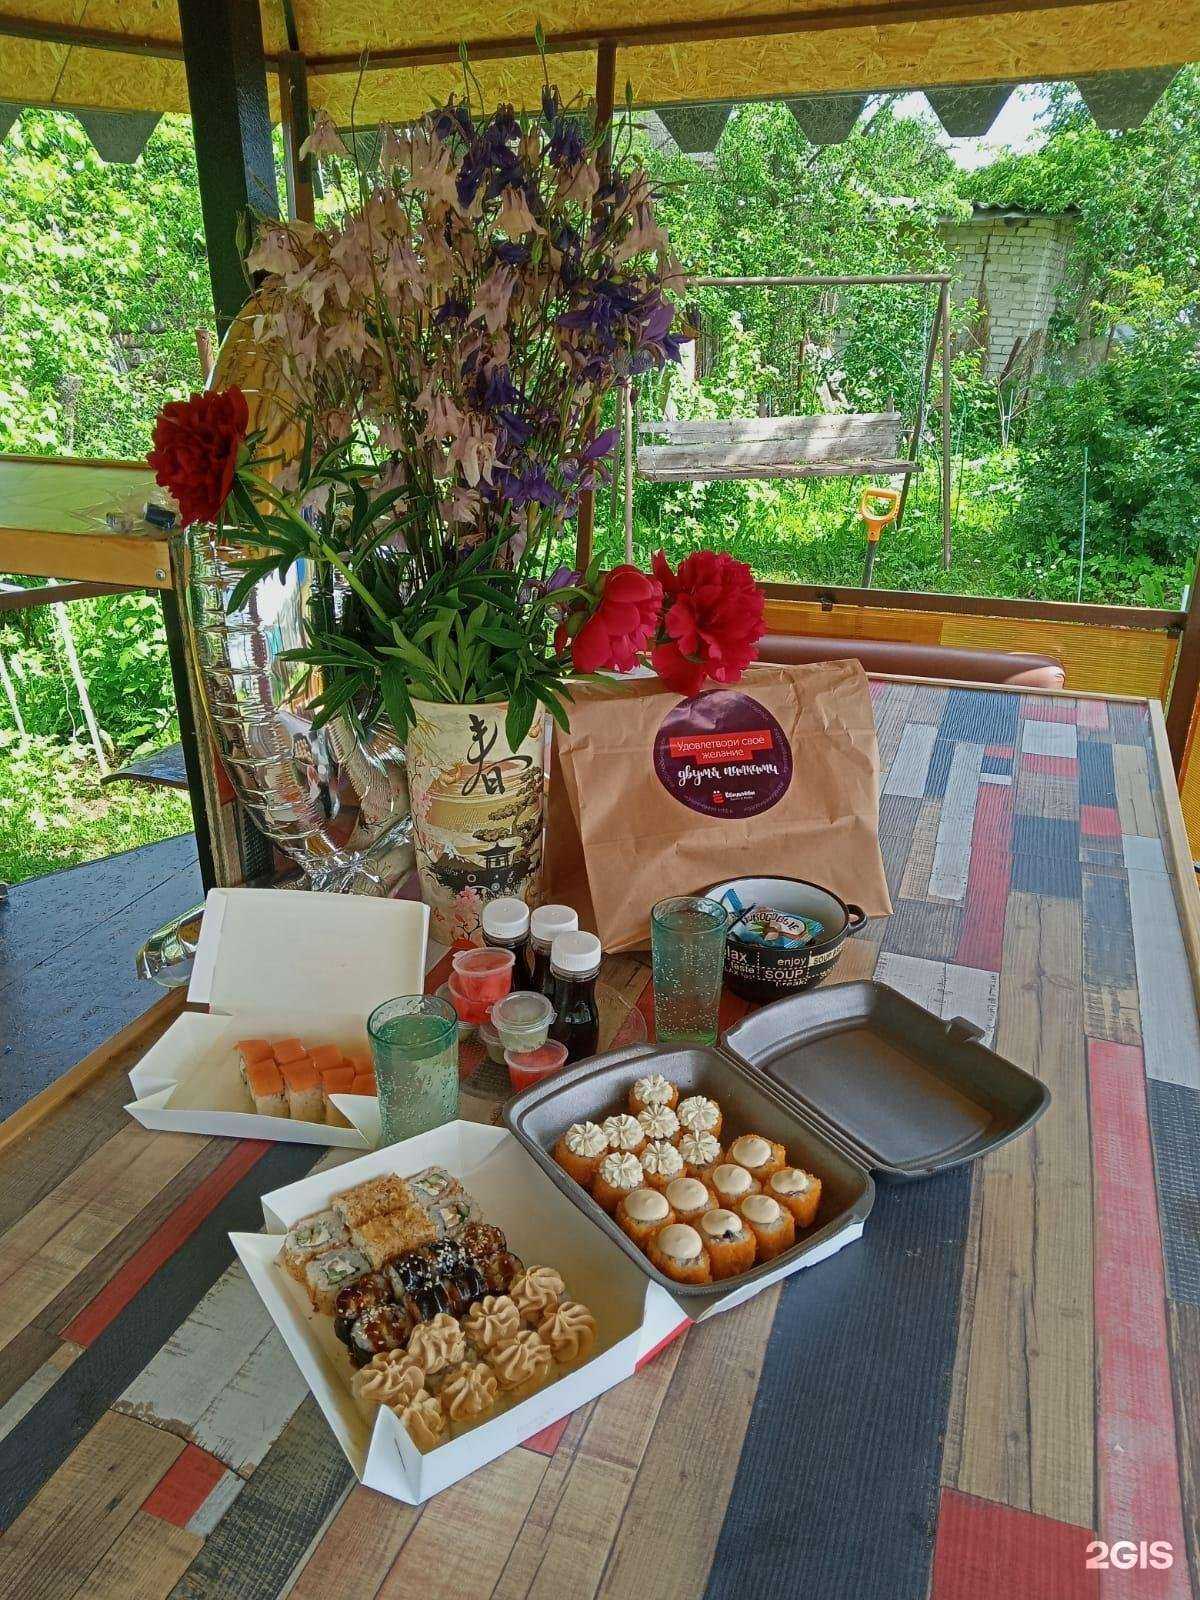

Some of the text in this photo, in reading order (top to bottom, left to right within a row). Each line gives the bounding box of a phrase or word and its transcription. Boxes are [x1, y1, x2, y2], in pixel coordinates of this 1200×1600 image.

[677, 736, 765, 752] Удовлетвори свое
[702, 748, 744, 760] желание
[677, 762, 780, 787] двумя палками
[777, 957, 807, 968] enjoy
[764, 969, 804, 980] SOUP
